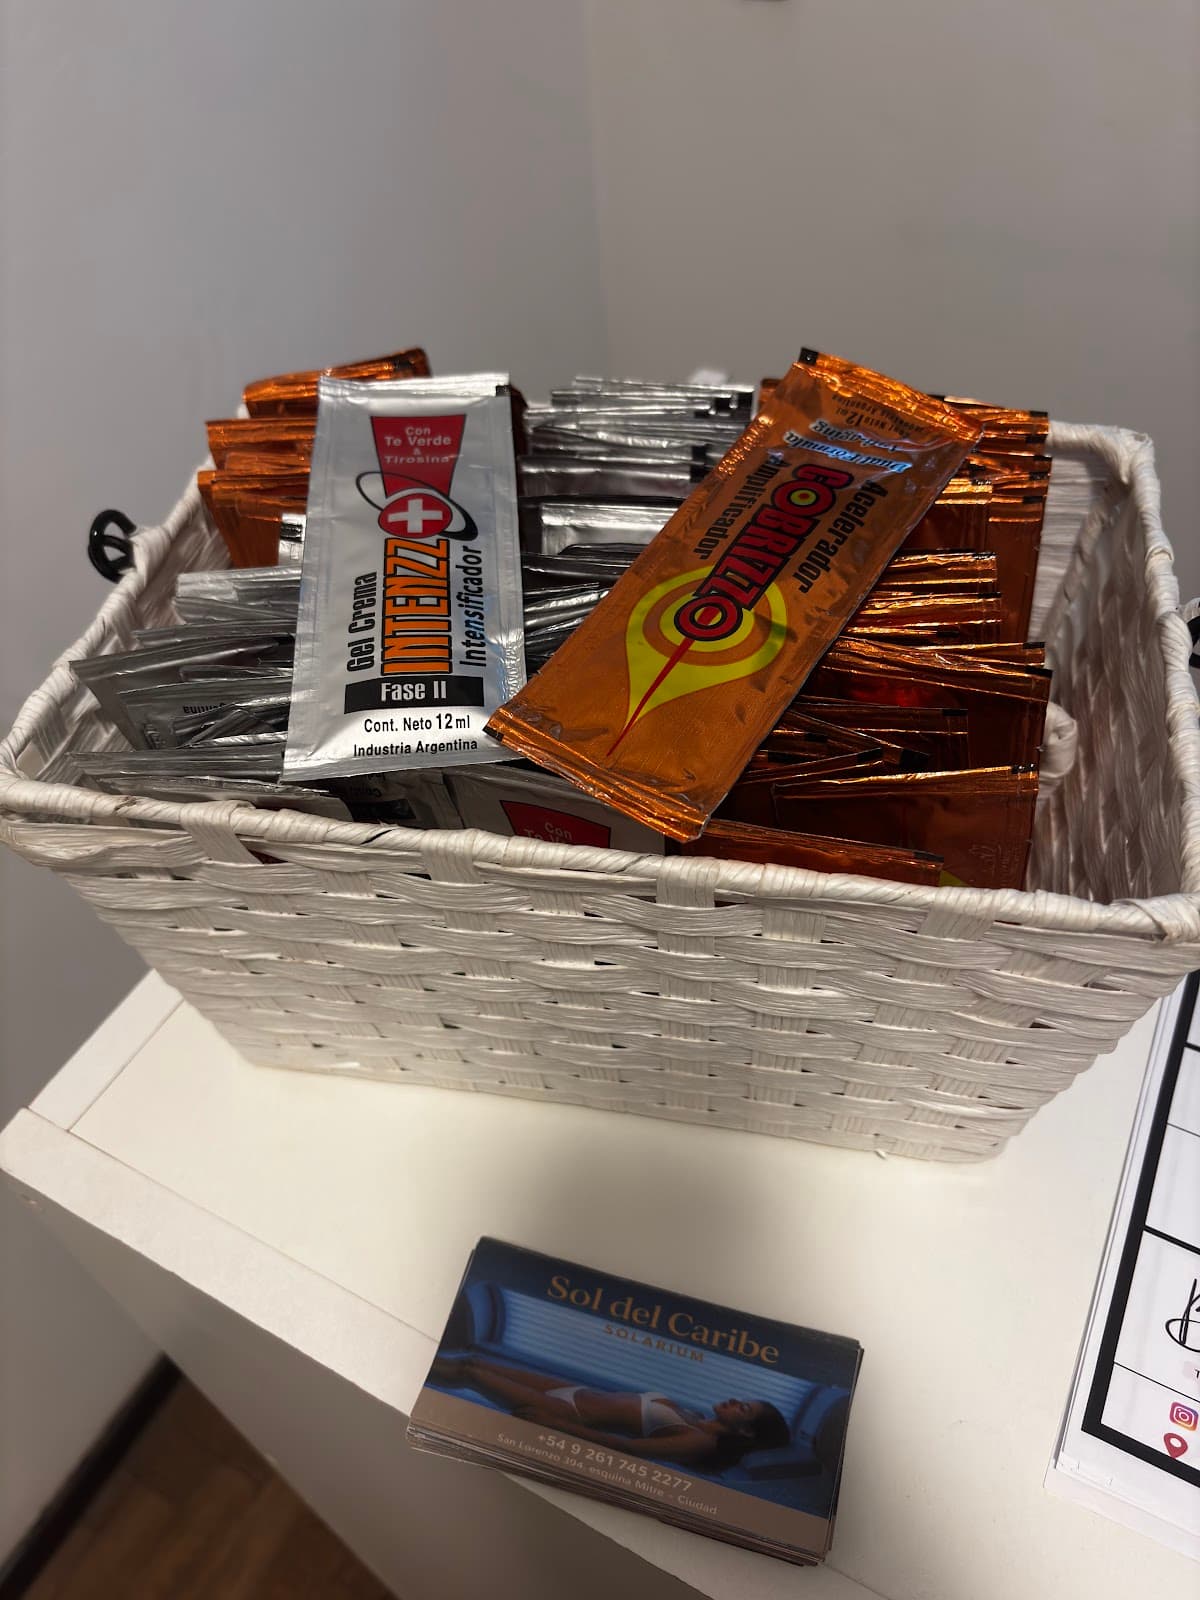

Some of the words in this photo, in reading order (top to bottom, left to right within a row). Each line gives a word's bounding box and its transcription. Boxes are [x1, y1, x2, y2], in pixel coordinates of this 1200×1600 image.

[384, 436, 402, 446] Te
[407, 435, 452, 446] Verde
[405, 426, 431, 436] Con
[384, 455, 450, 464] Tirosina
[859, 455, 912, 472] Dual
[693, 452, 792, 560] Amplificador
[674, 464, 855, 641] COBRIZZO
[792, 479, 889, 593] Acelerador
[349, 571, 378, 635] Crema
[456, 545, 487, 667] Intensificador
[347, 637, 376, 672] Gel
[380, 681, 426, 702] Fase
[433, 680, 447, 700] II
[364, 718, 399, 733] Cont.
[403, 715, 433, 732] Neto
[353, 741, 412, 757] Industria
[415, 738, 478, 754] Argentina
[545, 822, 572, 840] Con
[547, 1275, 604, 1313] Sol
[609, 1296, 661, 1327] del
[668, 1312, 780, 1364] Caribe
[604, 1324, 705, 1363] SOLARIUM
[497, 1433, 516, 1447] San
[518, 1440, 561, 1462] Lorenzo
[588, 1466, 632, 1485] esquina
[635, 1479, 665, 1498] Mitre
[677, 1494, 718, 1515] Ciudad
[538, 1435, 566, 1450] +54
[571, 1444, 582, 1456] 9
[585, 1448, 614, 1467] 261
[619, 1459, 648, 1477] 745
[651, 1470, 692, 1492] 2277
